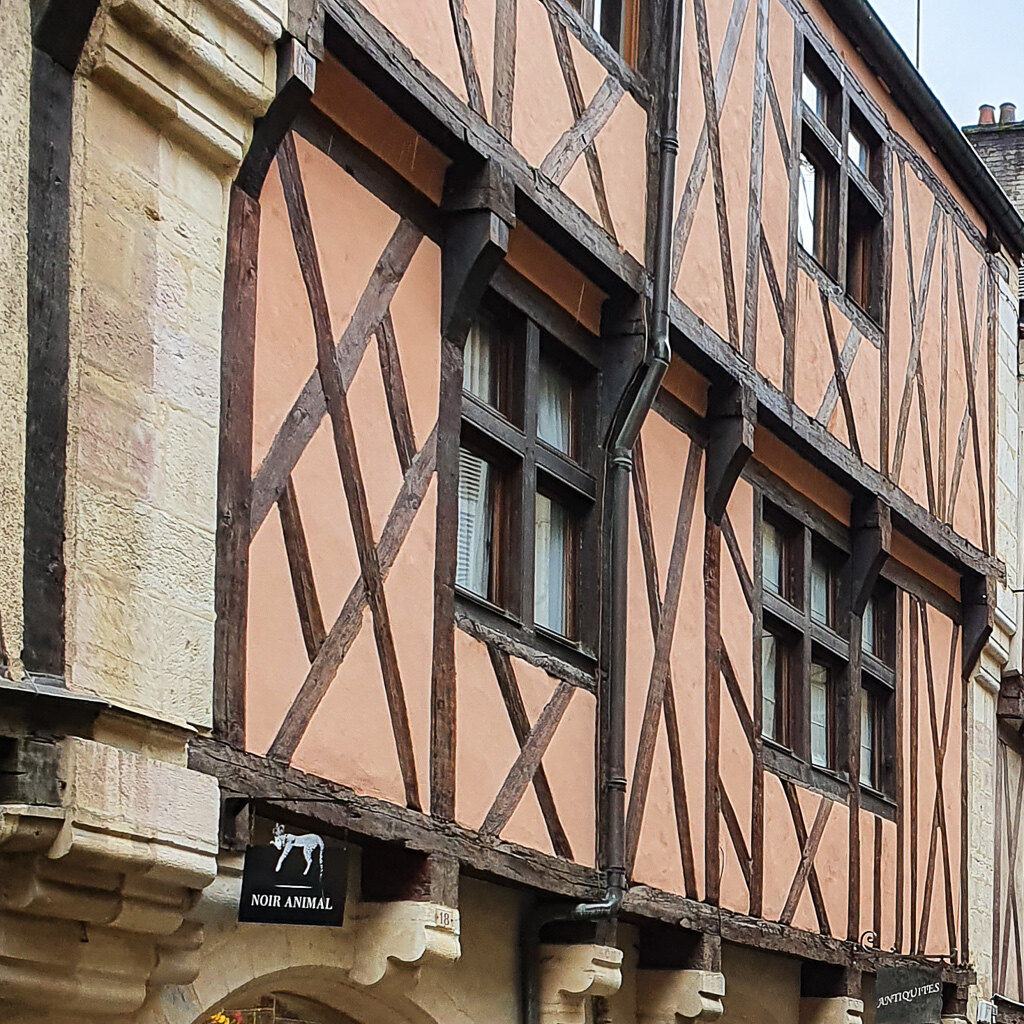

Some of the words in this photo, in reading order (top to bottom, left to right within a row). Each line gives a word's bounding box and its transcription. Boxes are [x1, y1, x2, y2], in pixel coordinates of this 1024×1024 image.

[251, 893, 281, 907] NOIR
[284, 895, 333, 910] ANIMAL
[439, 912, 450, 926] 18
[876, 982, 940, 1009] ANTIQUITES
